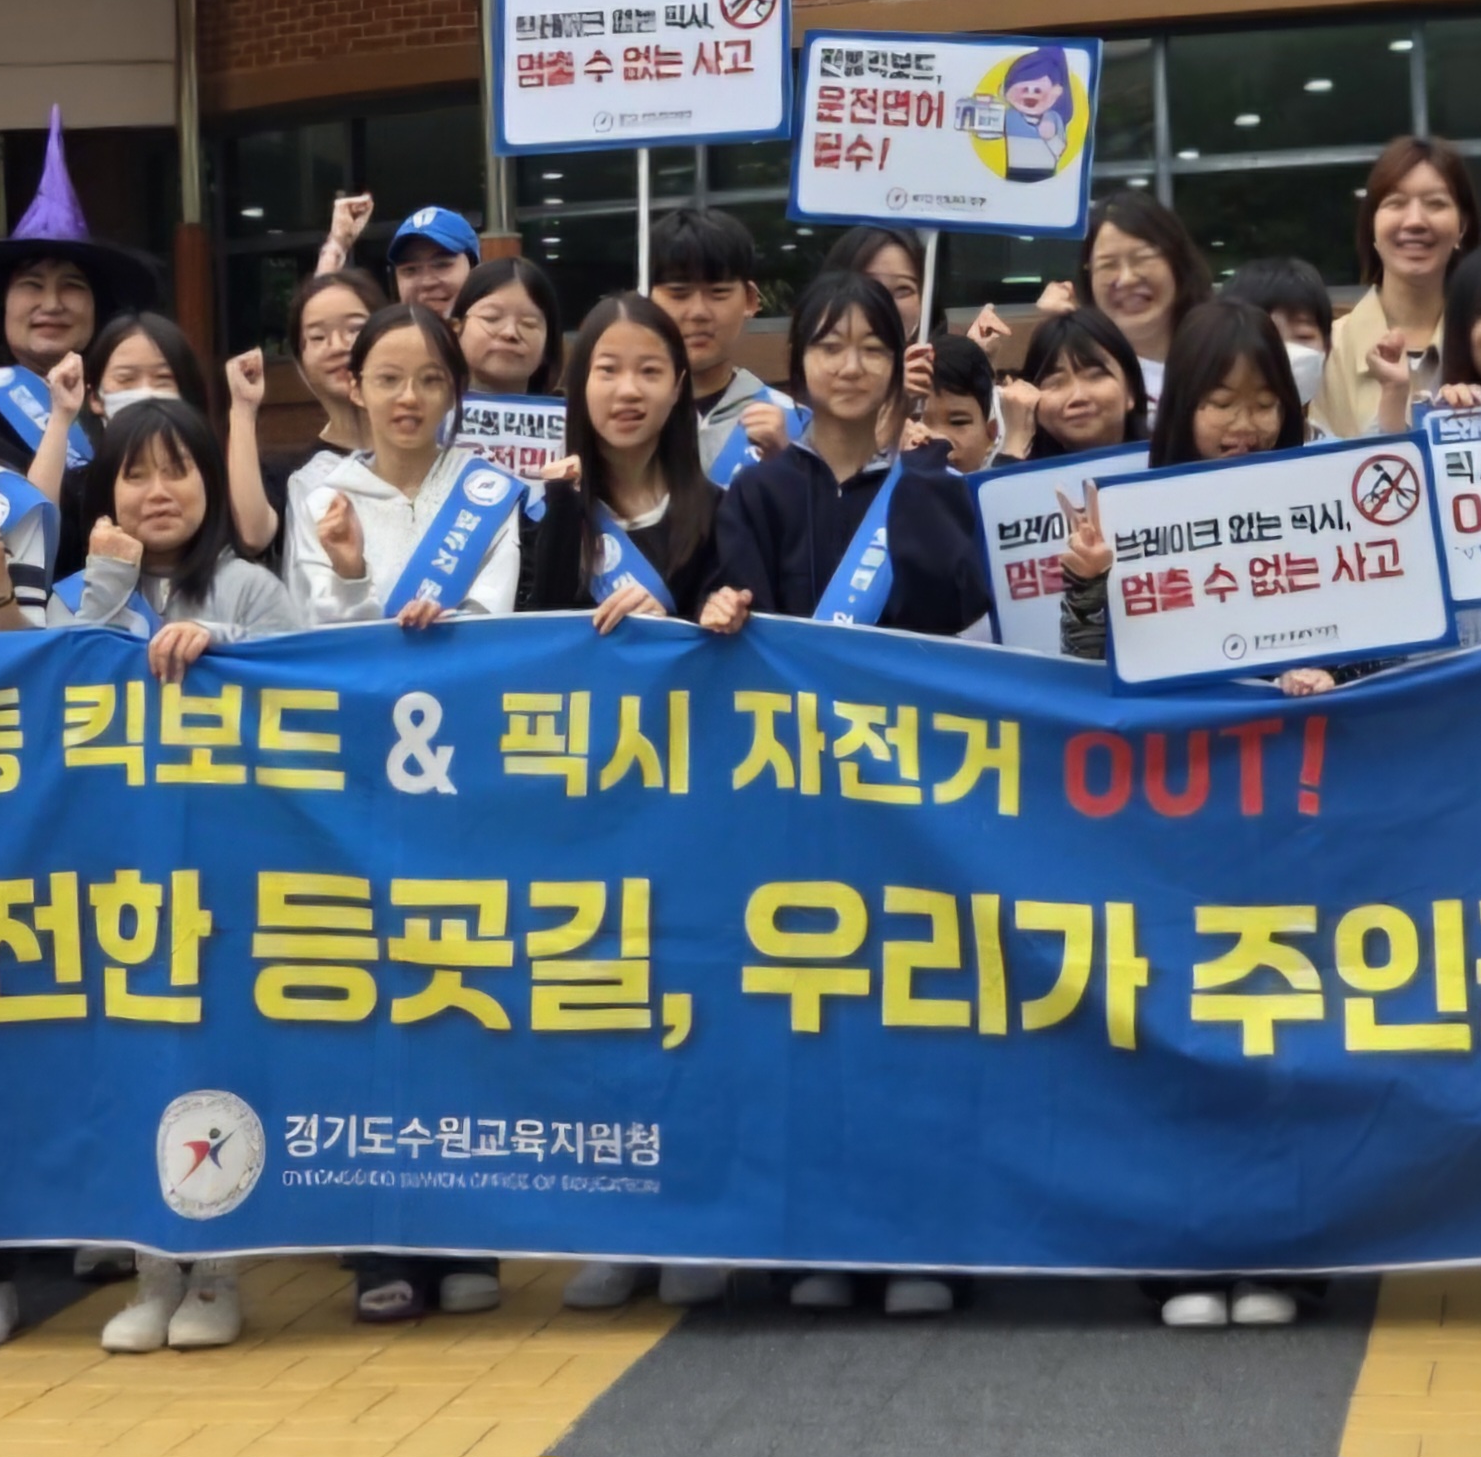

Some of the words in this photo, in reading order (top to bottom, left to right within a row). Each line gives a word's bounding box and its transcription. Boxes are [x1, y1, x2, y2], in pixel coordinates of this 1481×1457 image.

[583, 49, 614, 83] 수
[623, 44, 683, 81] 없는
[692, 39, 755, 76] 사고
[998, 512, 1070, 551] 브레이
[1115, 518, 1223, 562] 브레이크
[1228, 511, 1282, 544] 없는
[1203, 562, 1239, 603] 수
[1248, 552, 1321, 598] 없는
[1331, 538, 1405, 583] 사고
[62, 678, 346, 790] 킥보드
[385, 689, 458, 797] &
[500, 689, 690, 799] 픽시
[732, 689, 1022, 818] 자전거
[1063, 713, 1328, 820] OUT!
[251, 870, 694, 1052] 등굣길,
[740, 877, 1150, 1051] 우리가
[284, 1112, 662, 1167] 경기도수원교육지원청
